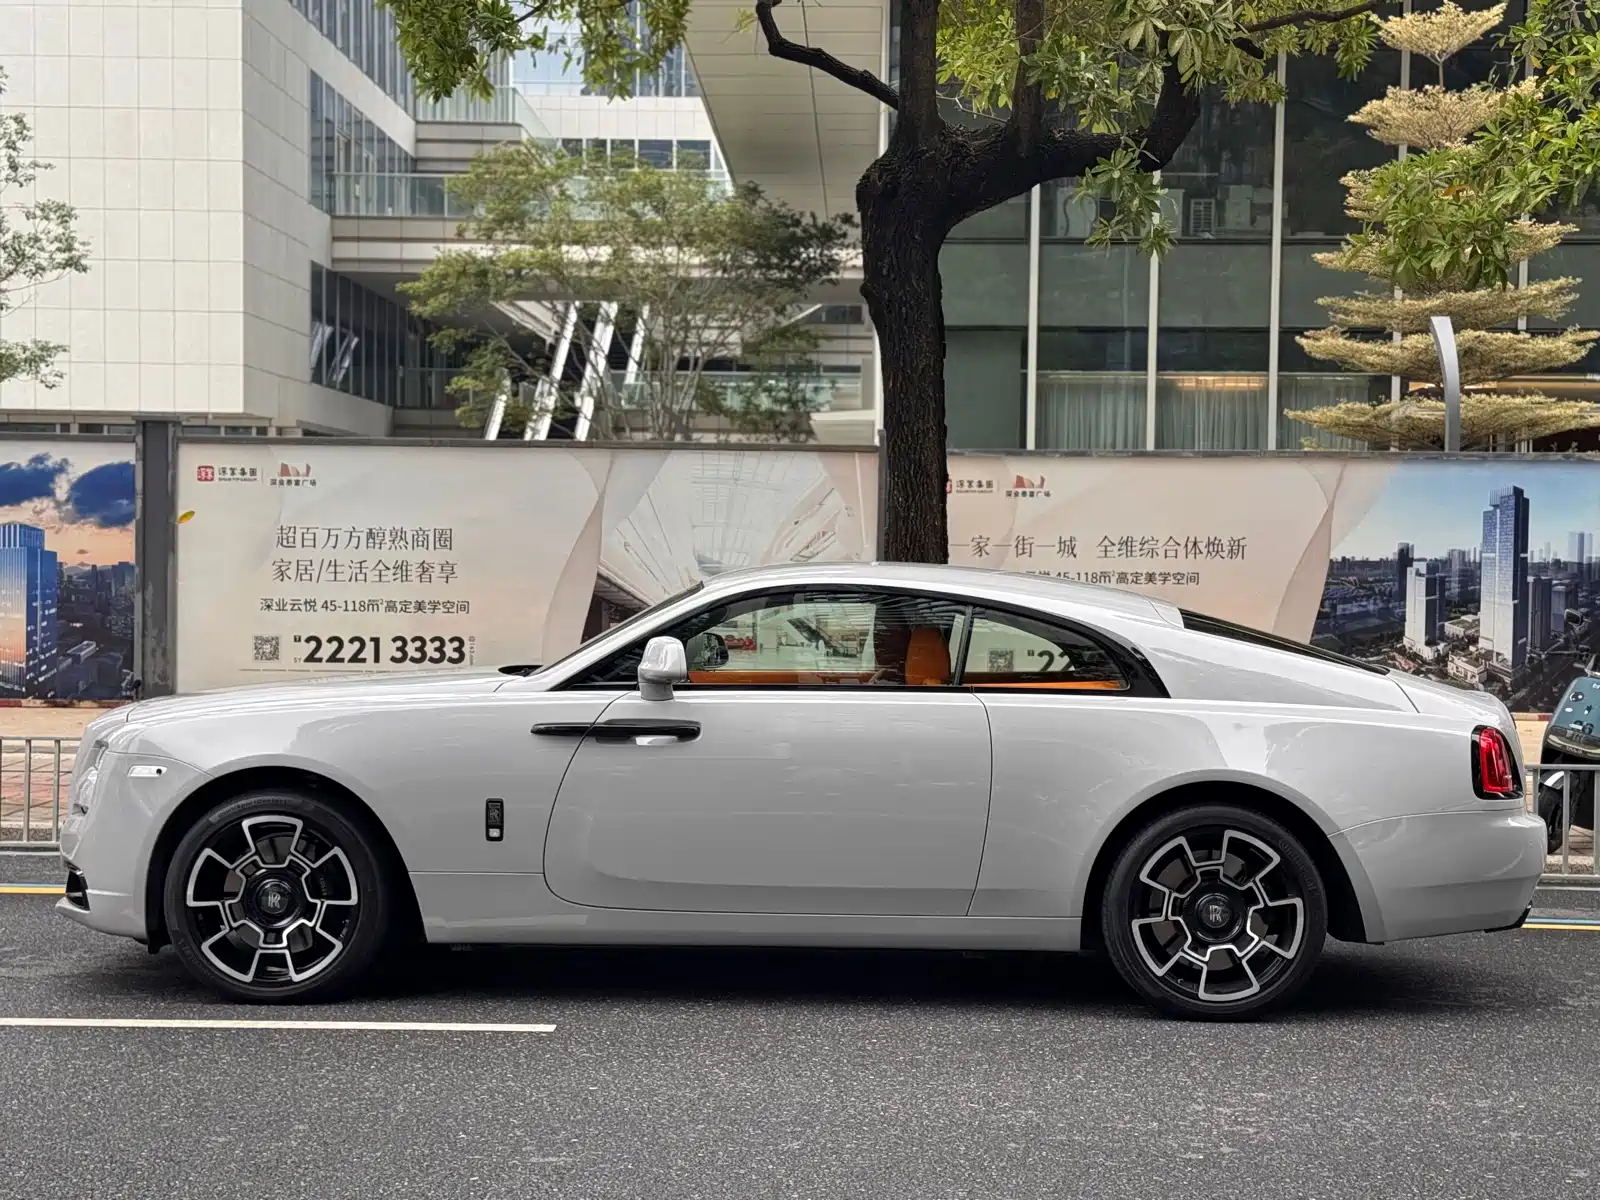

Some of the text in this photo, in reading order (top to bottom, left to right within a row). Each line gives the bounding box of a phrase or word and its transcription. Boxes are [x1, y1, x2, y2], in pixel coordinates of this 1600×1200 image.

[275, 525, 453, 551] 超百万方醇熟商圈
[949, 534, 1248, 561] 一家一街一城 全维综合体焕新
[271, 558, 458, 584] 家居/生活全维奢享
[259, 598, 318, 613] 深业云悦
[303, 634, 466, 665] 2221 3333
